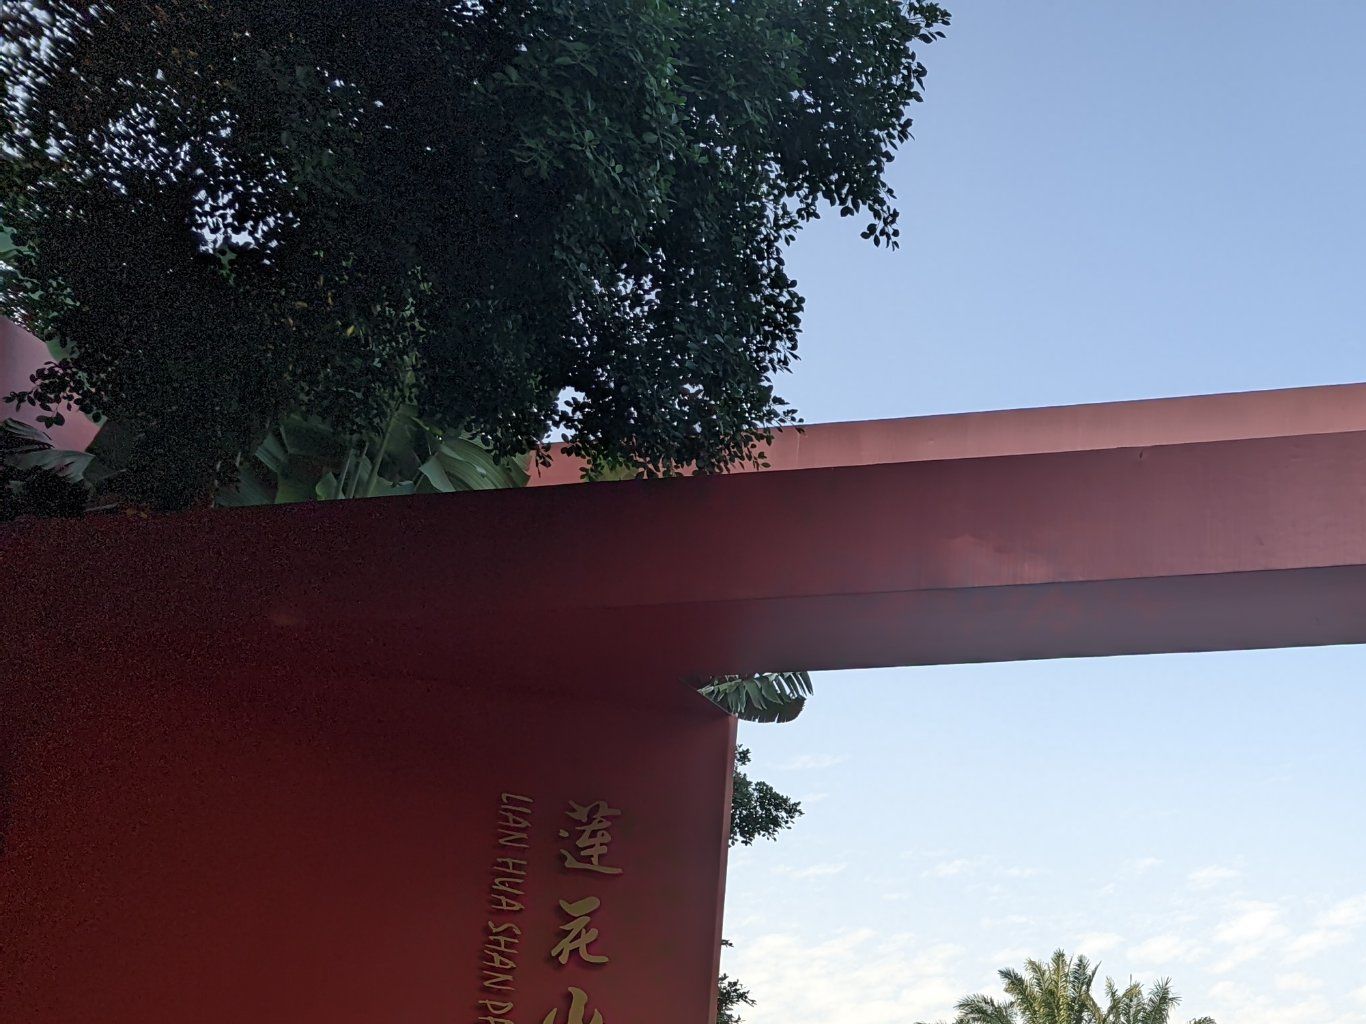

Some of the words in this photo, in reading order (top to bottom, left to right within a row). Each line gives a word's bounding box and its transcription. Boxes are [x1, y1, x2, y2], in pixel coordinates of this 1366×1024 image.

[499, 792, 534, 849] LIAN
[491, 857, 527, 911] HUA
[482, 920, 522, 991] SHAN
